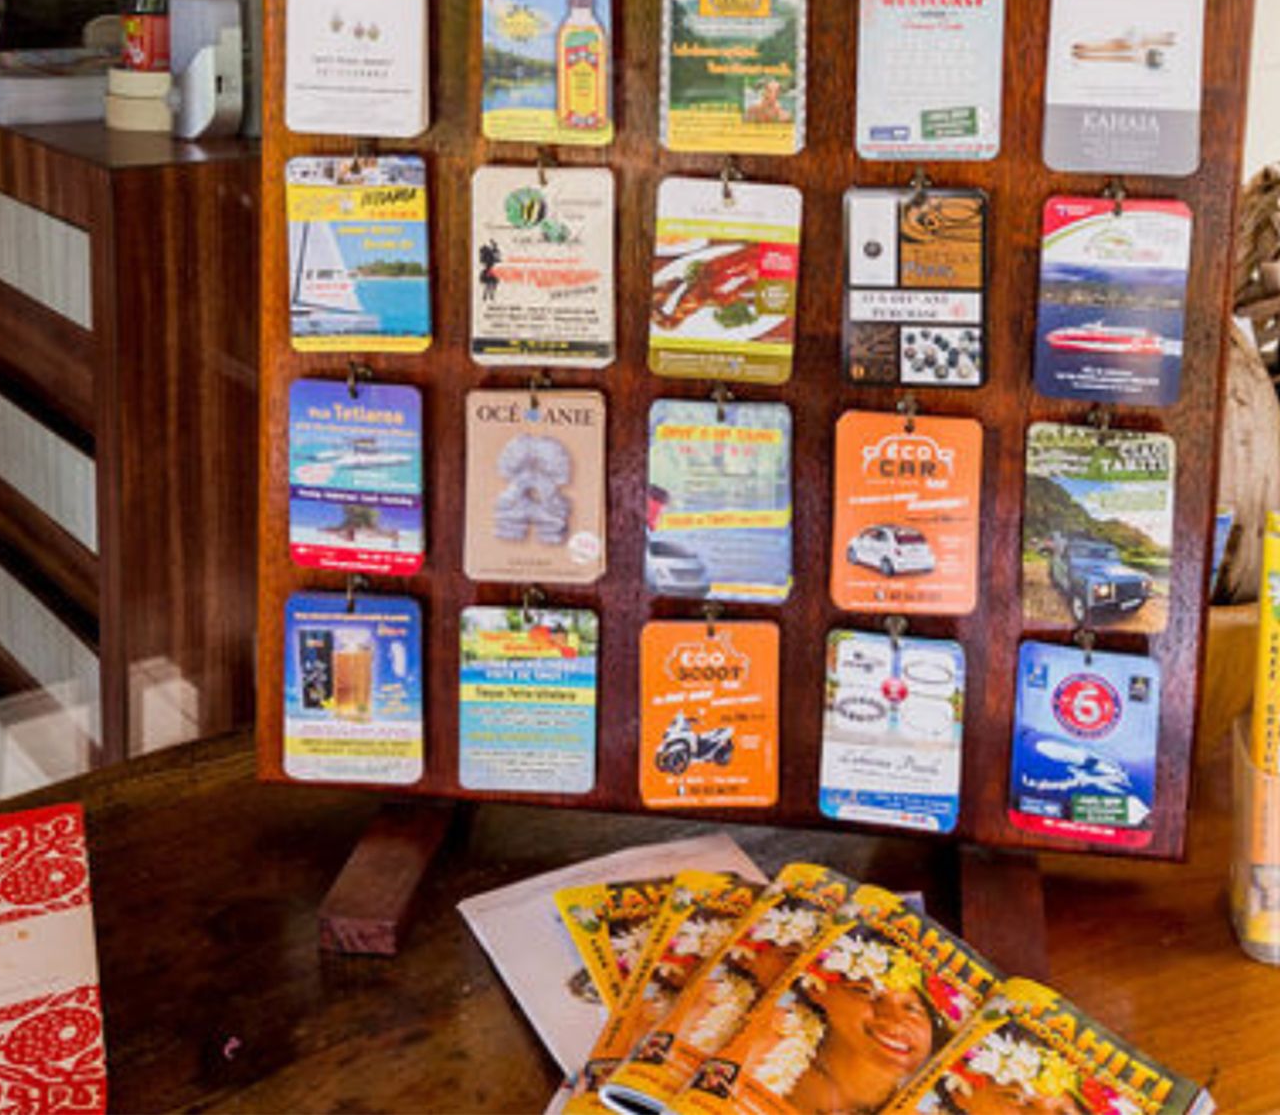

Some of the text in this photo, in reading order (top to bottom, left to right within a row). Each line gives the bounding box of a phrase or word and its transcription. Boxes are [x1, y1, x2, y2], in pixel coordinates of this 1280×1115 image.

[879, 459, 937, 477] CAR
[678, 666, 744, 681] SCOOT
[867, 903, 998, 991] TAHIT
[1024, 1004, 1174, 1102] TAHITI
